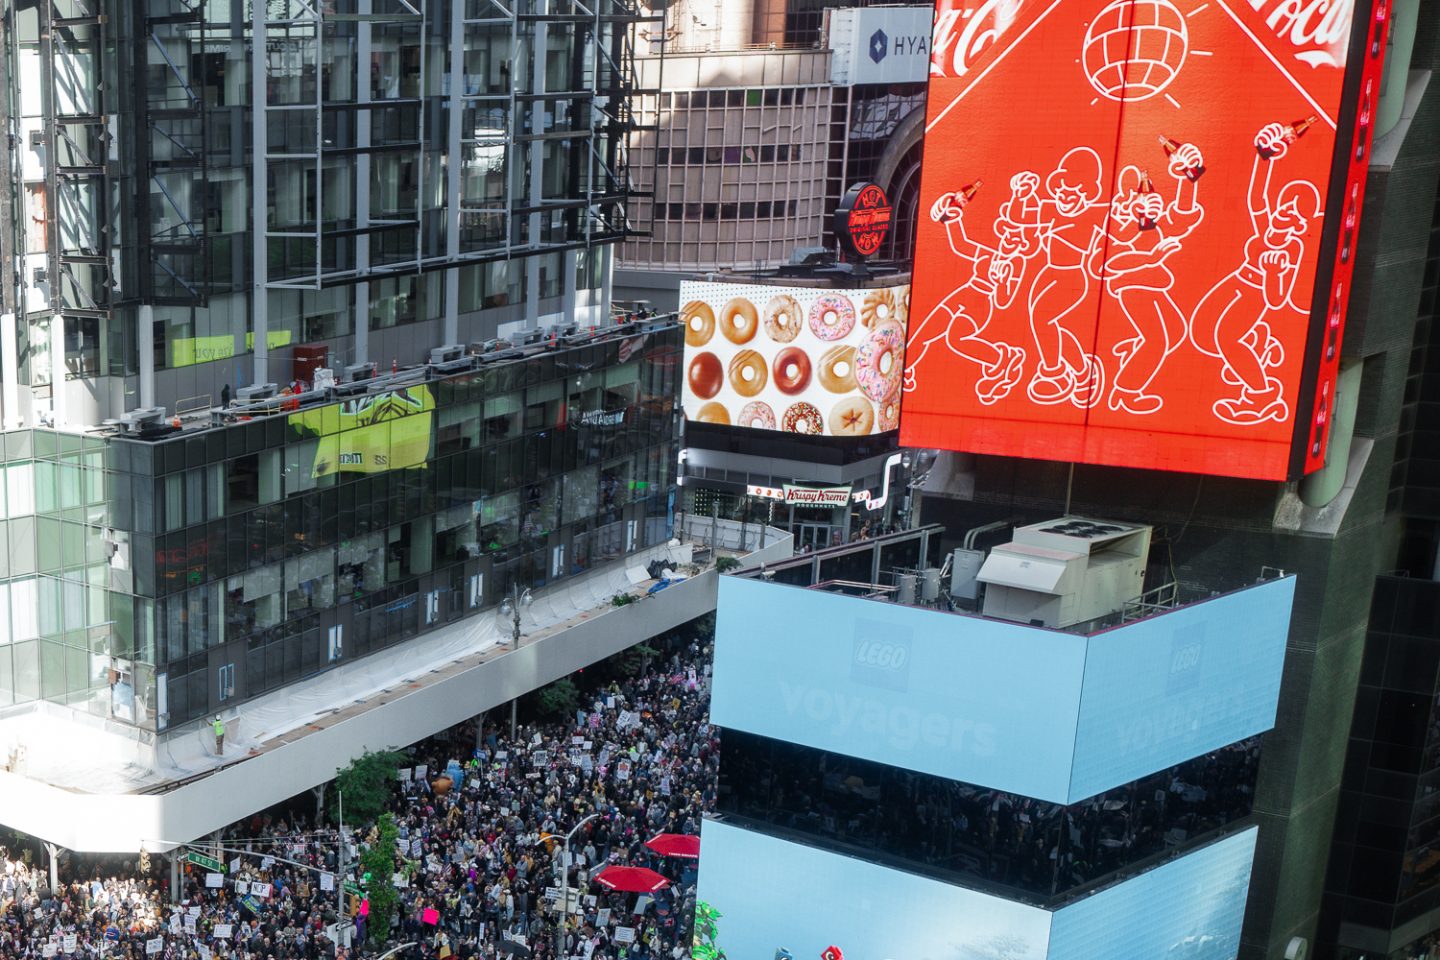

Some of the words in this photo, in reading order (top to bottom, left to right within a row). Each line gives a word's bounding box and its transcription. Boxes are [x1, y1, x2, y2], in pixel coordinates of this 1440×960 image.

[787, 489, 818, 503] Krispy
[818, 490, 848, 503] Kreme
[855, 638, 909, 672] LEGO
[779, 678, 997, 757] voyagers
